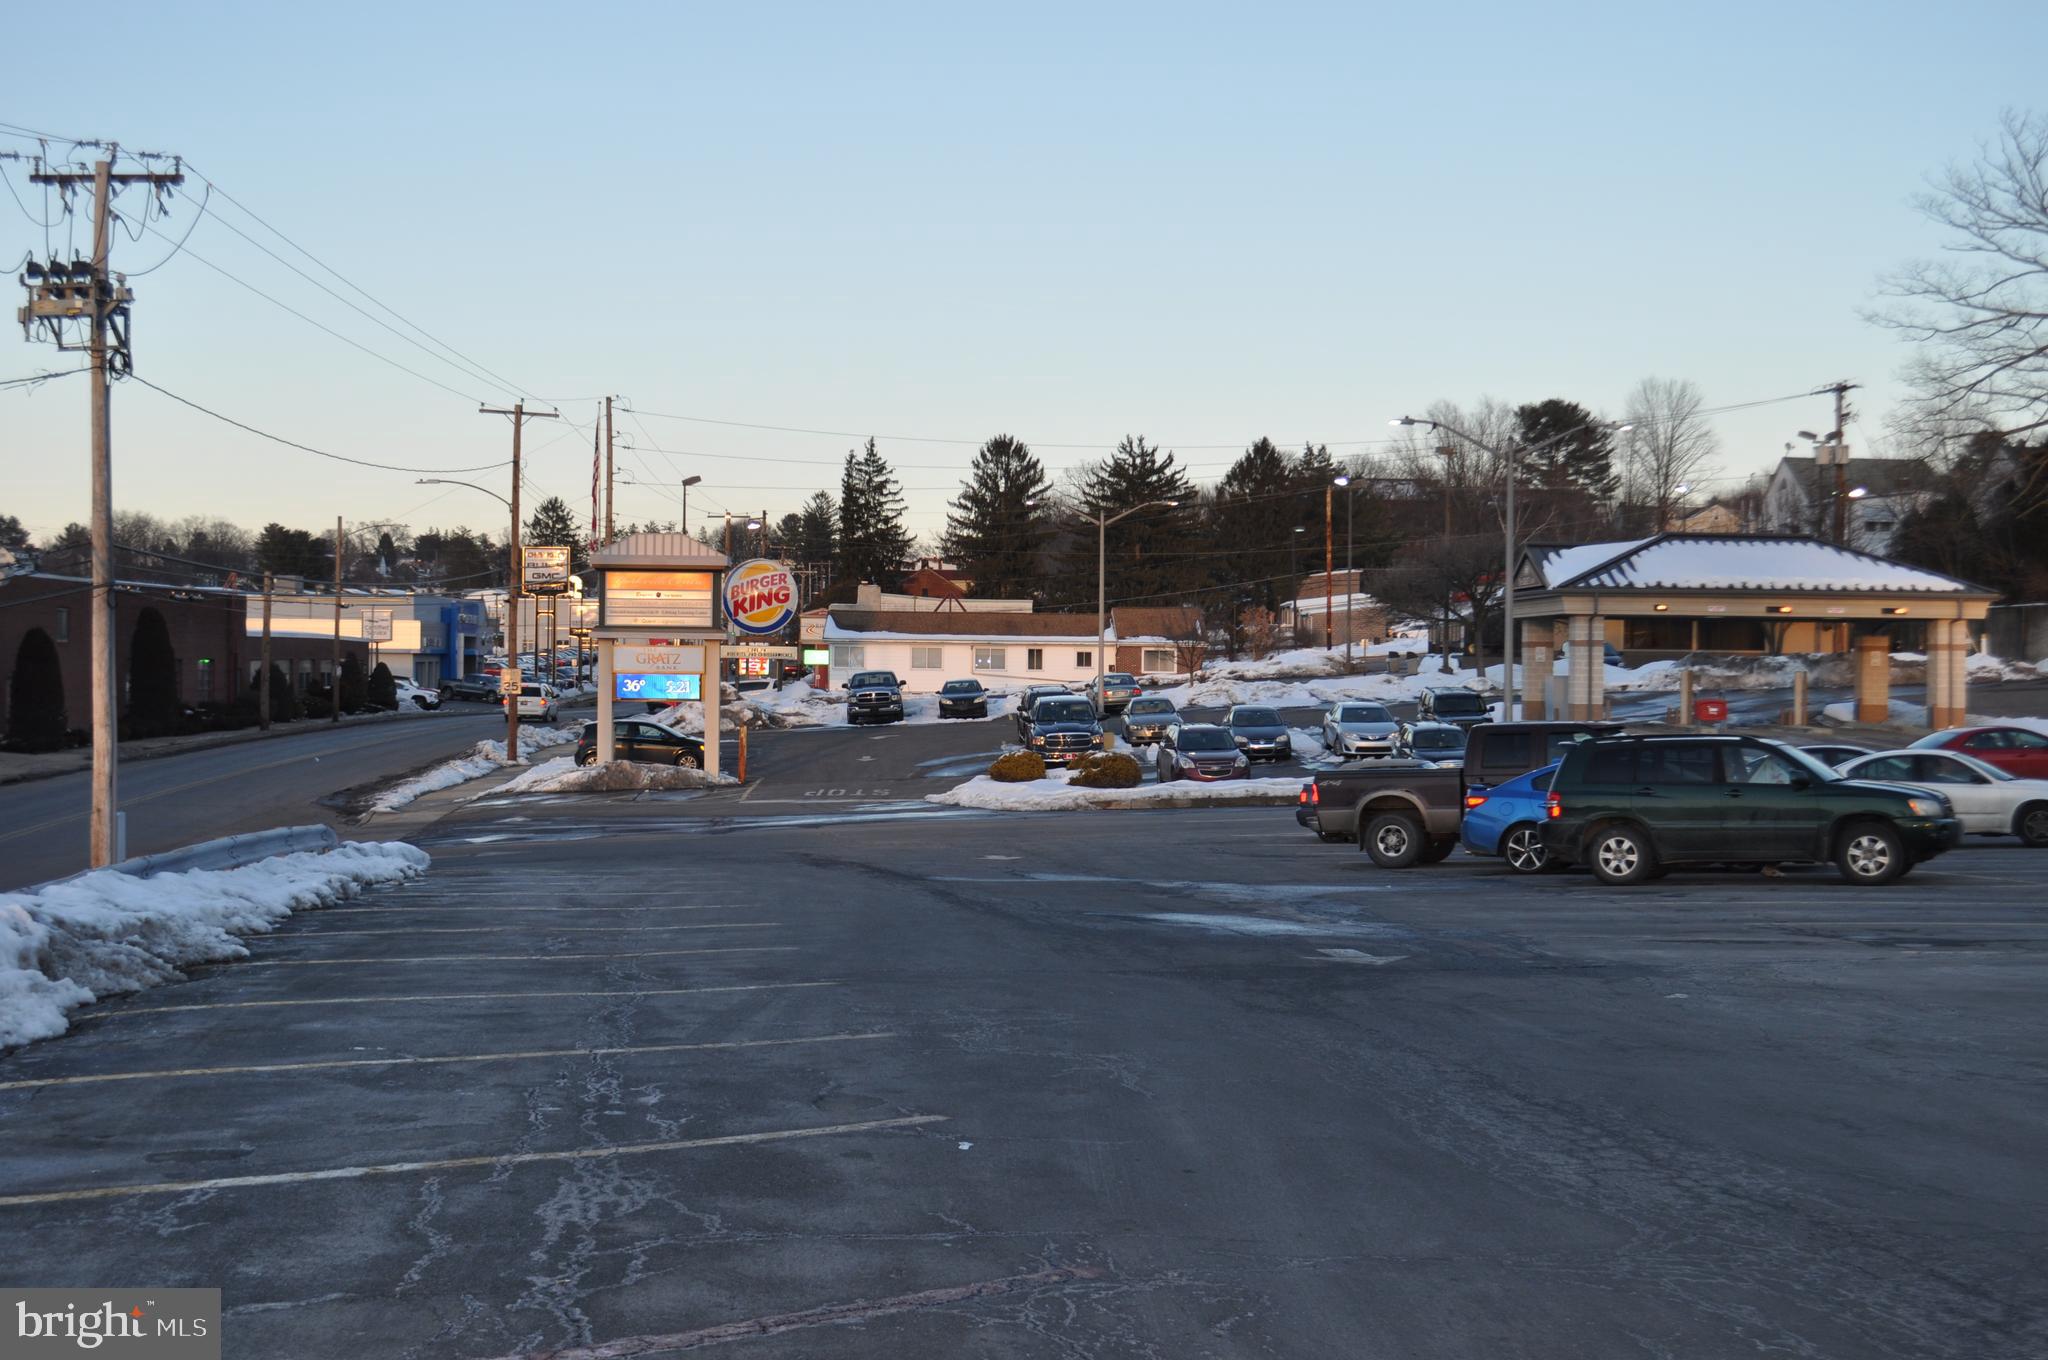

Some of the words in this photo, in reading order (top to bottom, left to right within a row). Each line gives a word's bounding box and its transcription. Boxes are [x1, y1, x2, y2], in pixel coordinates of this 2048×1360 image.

[731, 573, 788, 600] BURGER
[733, 586, 790, 618] KING
[636, 653, 681, 665] GRATZ
[503, 681, 519, 691] 35
[804, 789, 891, 797] STOP
